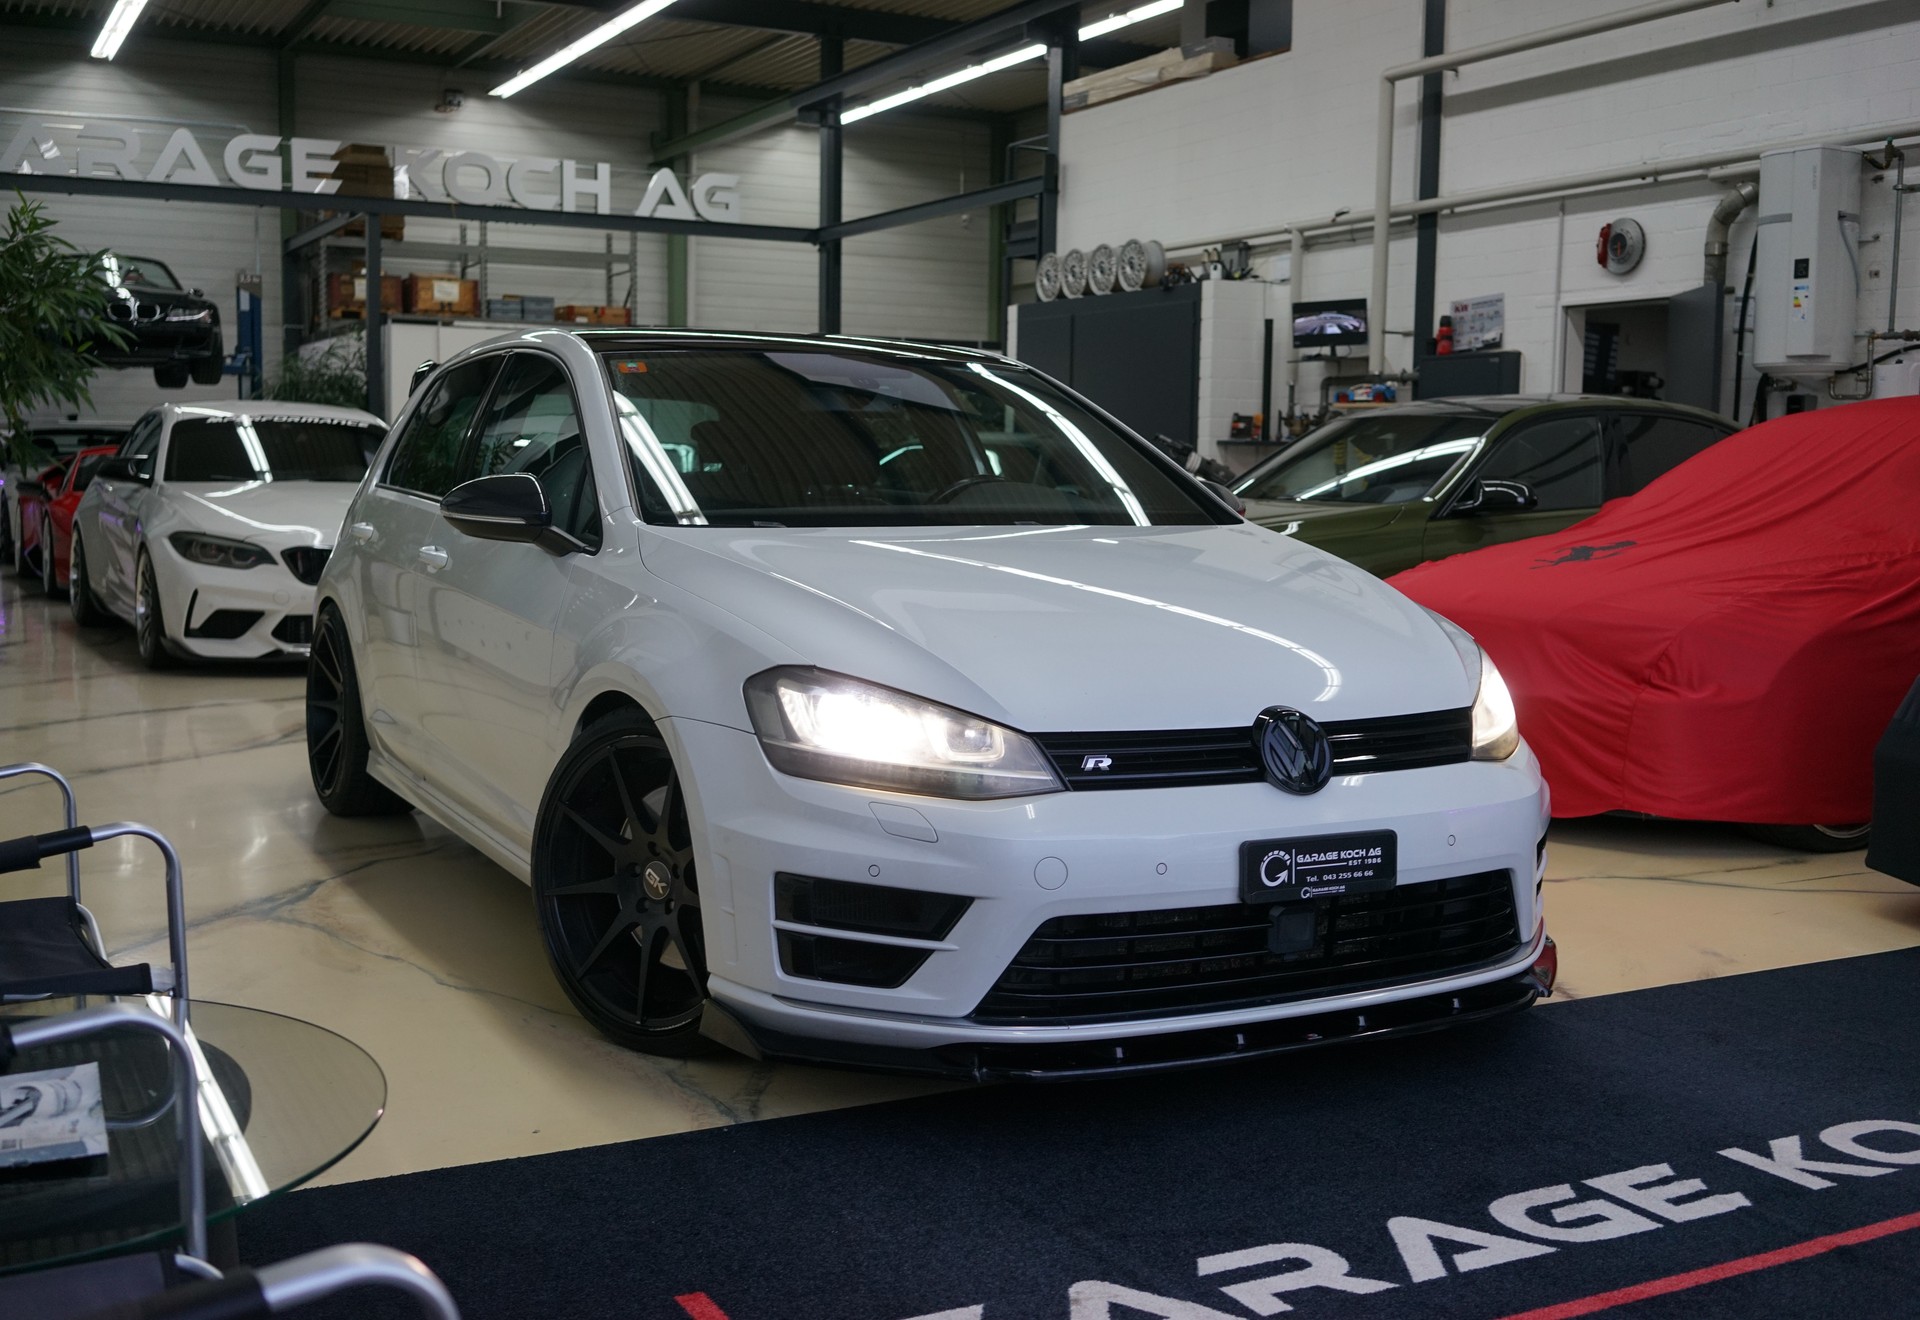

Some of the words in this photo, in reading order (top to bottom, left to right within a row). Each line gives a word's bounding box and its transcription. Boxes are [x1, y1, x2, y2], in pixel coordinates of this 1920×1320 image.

[394, 150, 611, 215] KOCH
[634, 167, 740, 223] AG
[1081, 754, 1113, 771] R
[1297, 852, 1339, 863] GARAGE
[1340, 849, 1366, 859] KOCH
[1367, 847, 1382, 856] AG
